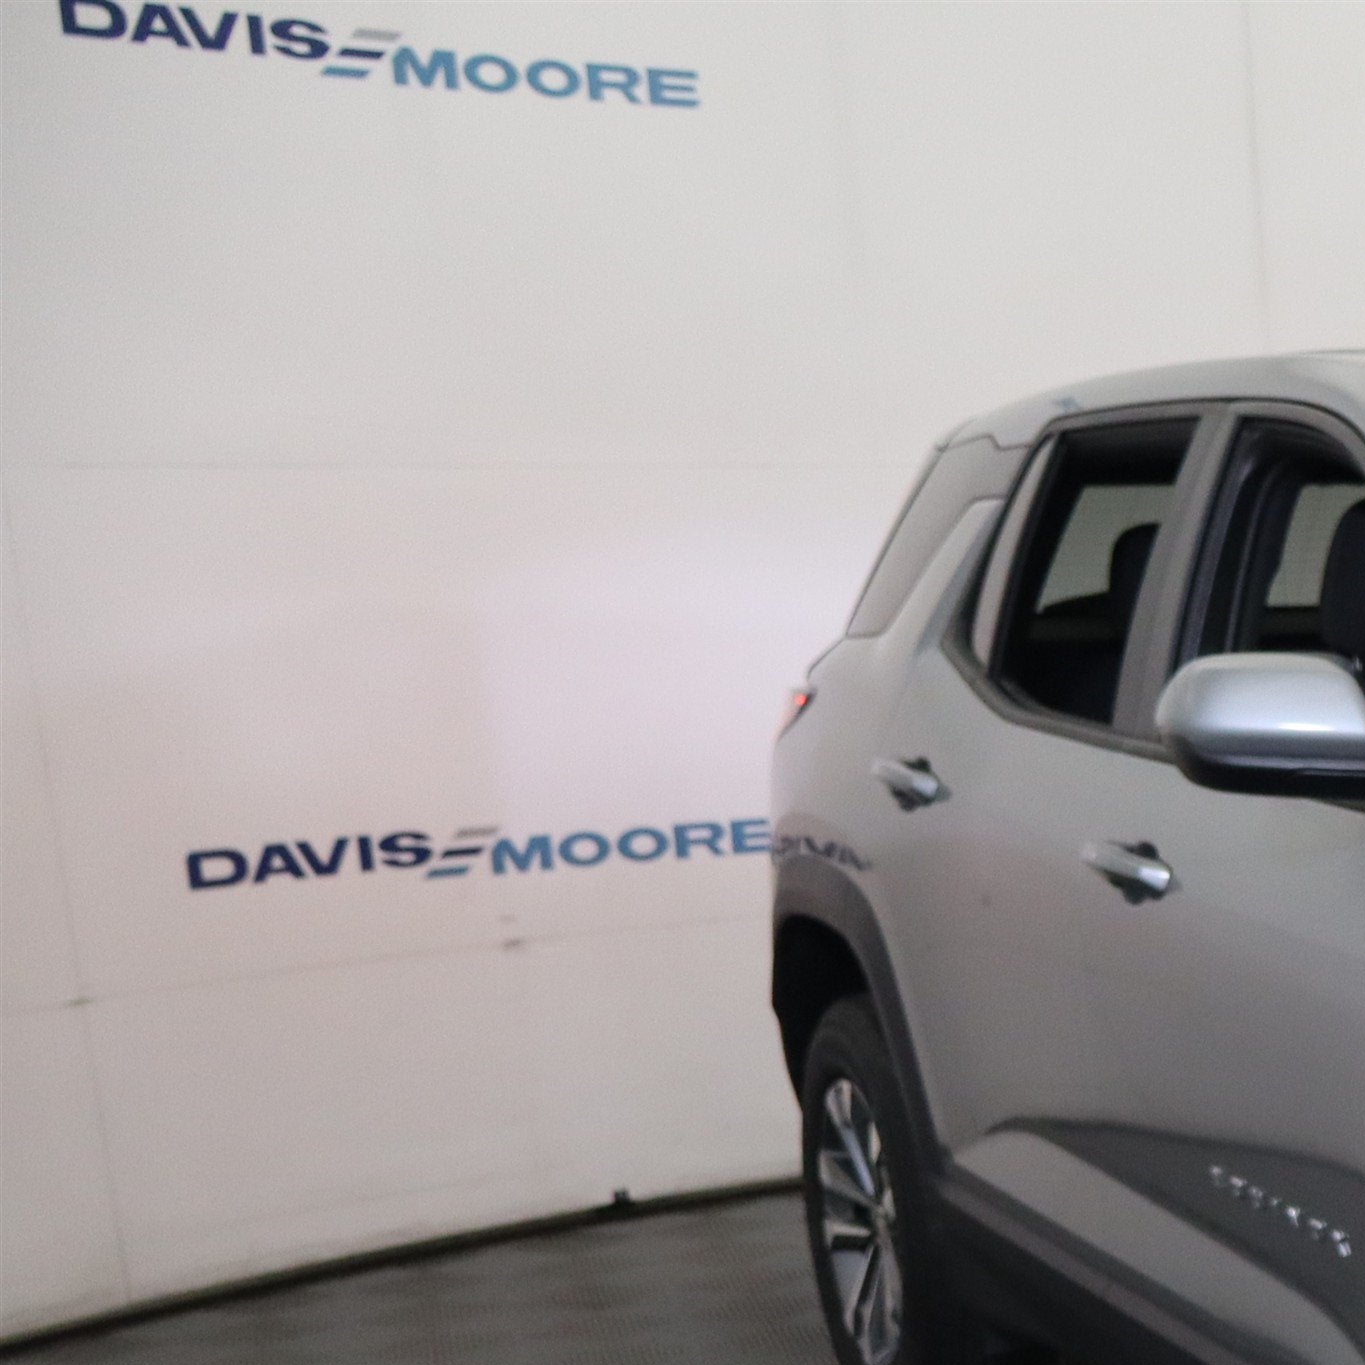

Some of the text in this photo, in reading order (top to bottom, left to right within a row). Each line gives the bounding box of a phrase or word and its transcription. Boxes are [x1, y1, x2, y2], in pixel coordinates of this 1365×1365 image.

[57, 0, 699, 108] DAVIS MOORE
[184, 829, 432, 891] DAVIS
[490, 818, 770, 876] MOORE
